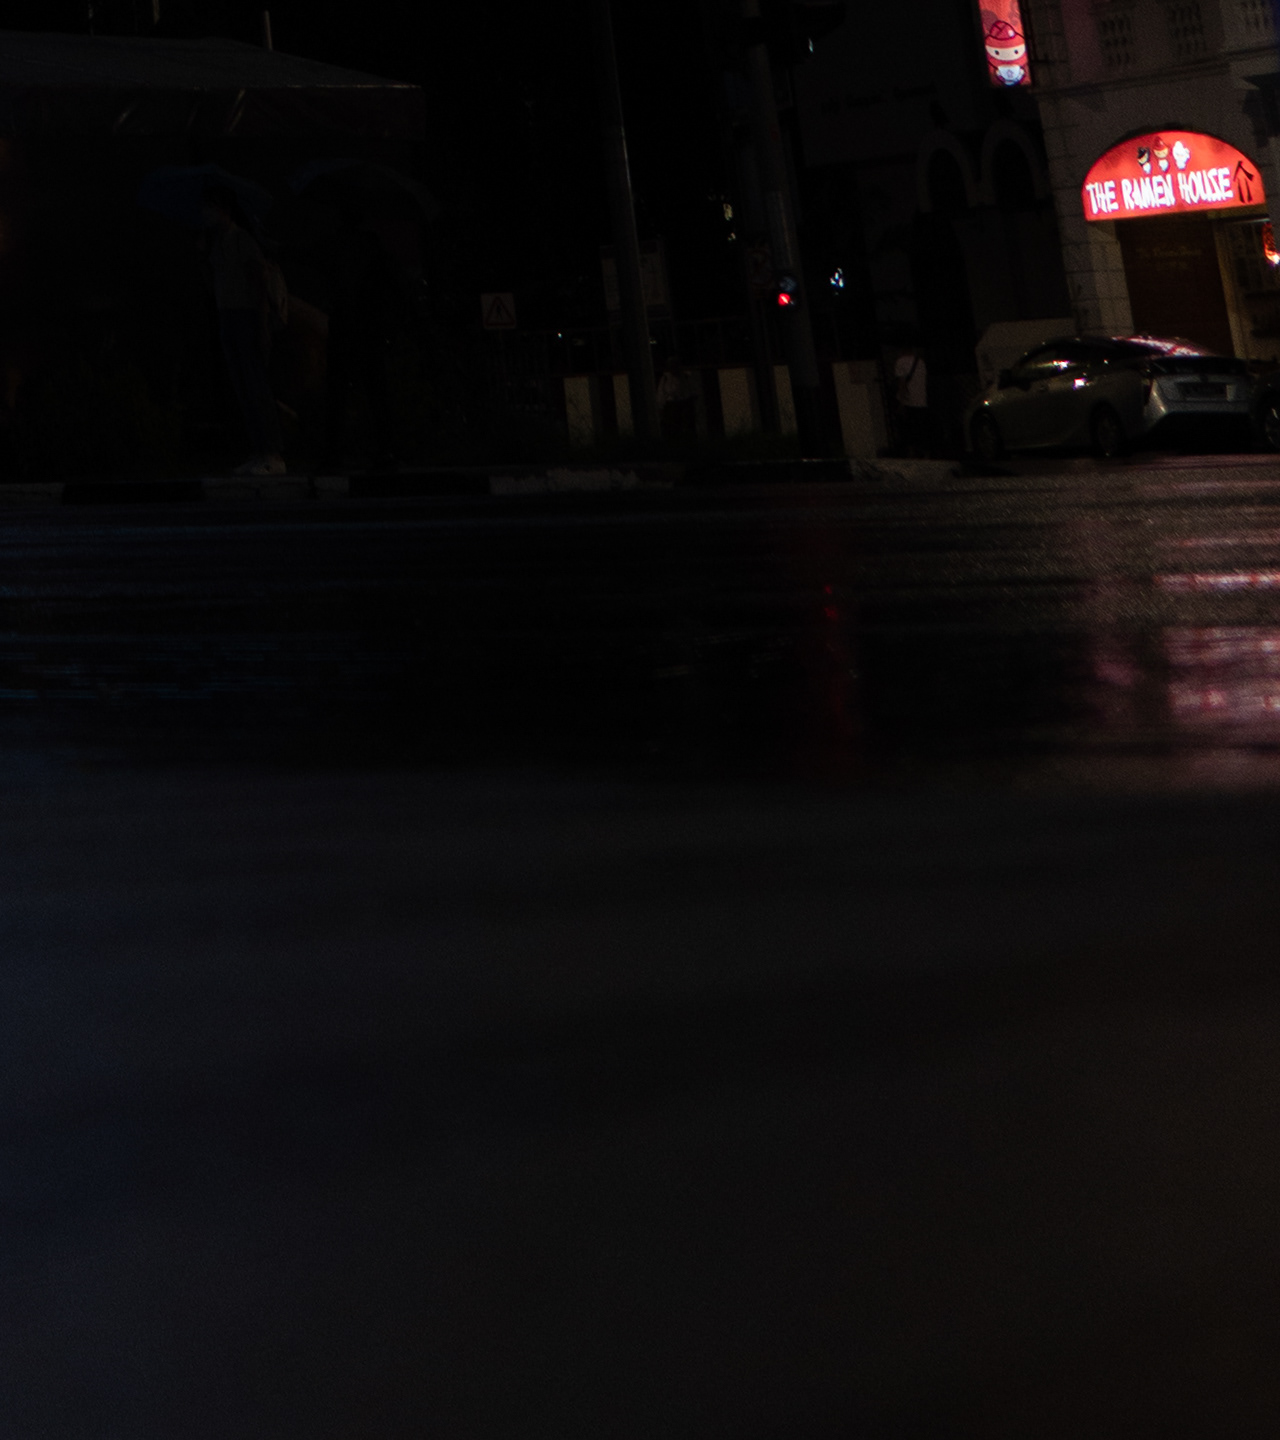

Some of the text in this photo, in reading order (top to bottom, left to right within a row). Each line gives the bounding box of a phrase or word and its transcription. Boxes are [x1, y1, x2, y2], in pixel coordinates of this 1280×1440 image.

[1086, 167, 1234, 215] THE RAMEN HOUSE
